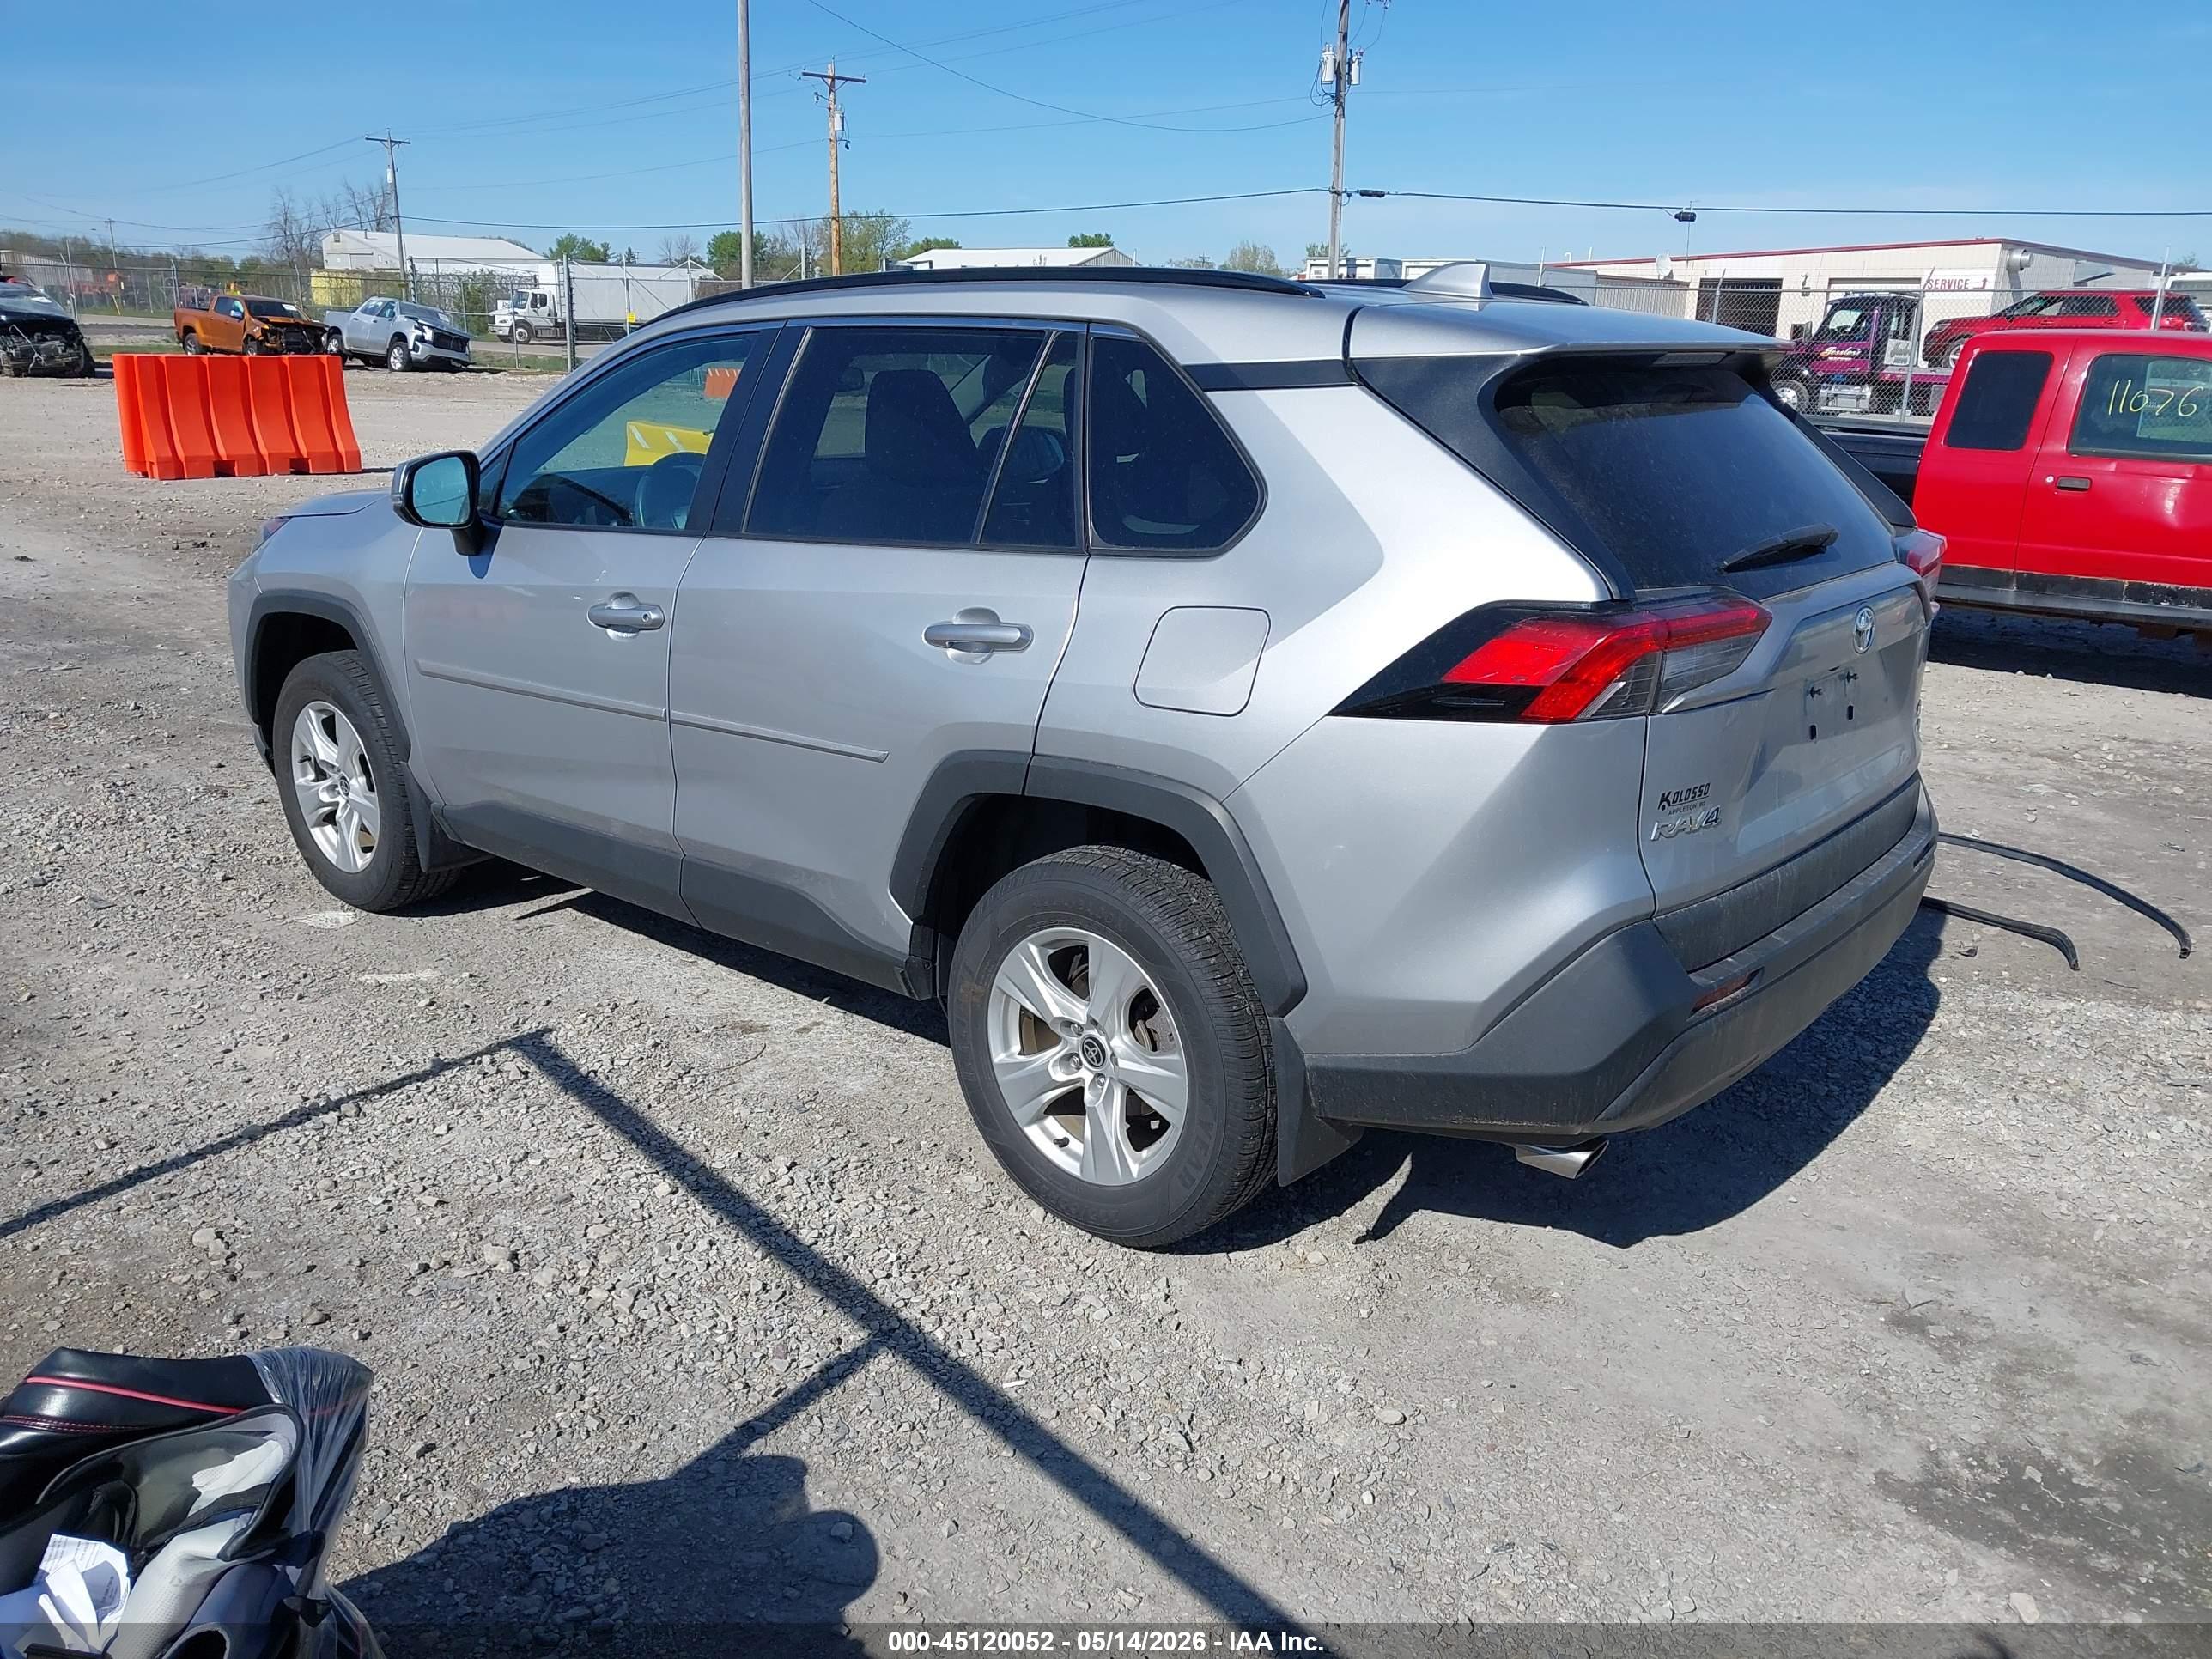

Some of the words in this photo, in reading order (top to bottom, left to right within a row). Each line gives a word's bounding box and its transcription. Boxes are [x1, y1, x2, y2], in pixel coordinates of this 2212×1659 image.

[1927, 278, 1971, 290] SERVICE
[2108, 379, 2204, 417] 11076
[1657, 782, 1711, 811] KOLOSSO
[1650, 805, 1721, 842] RAV4
